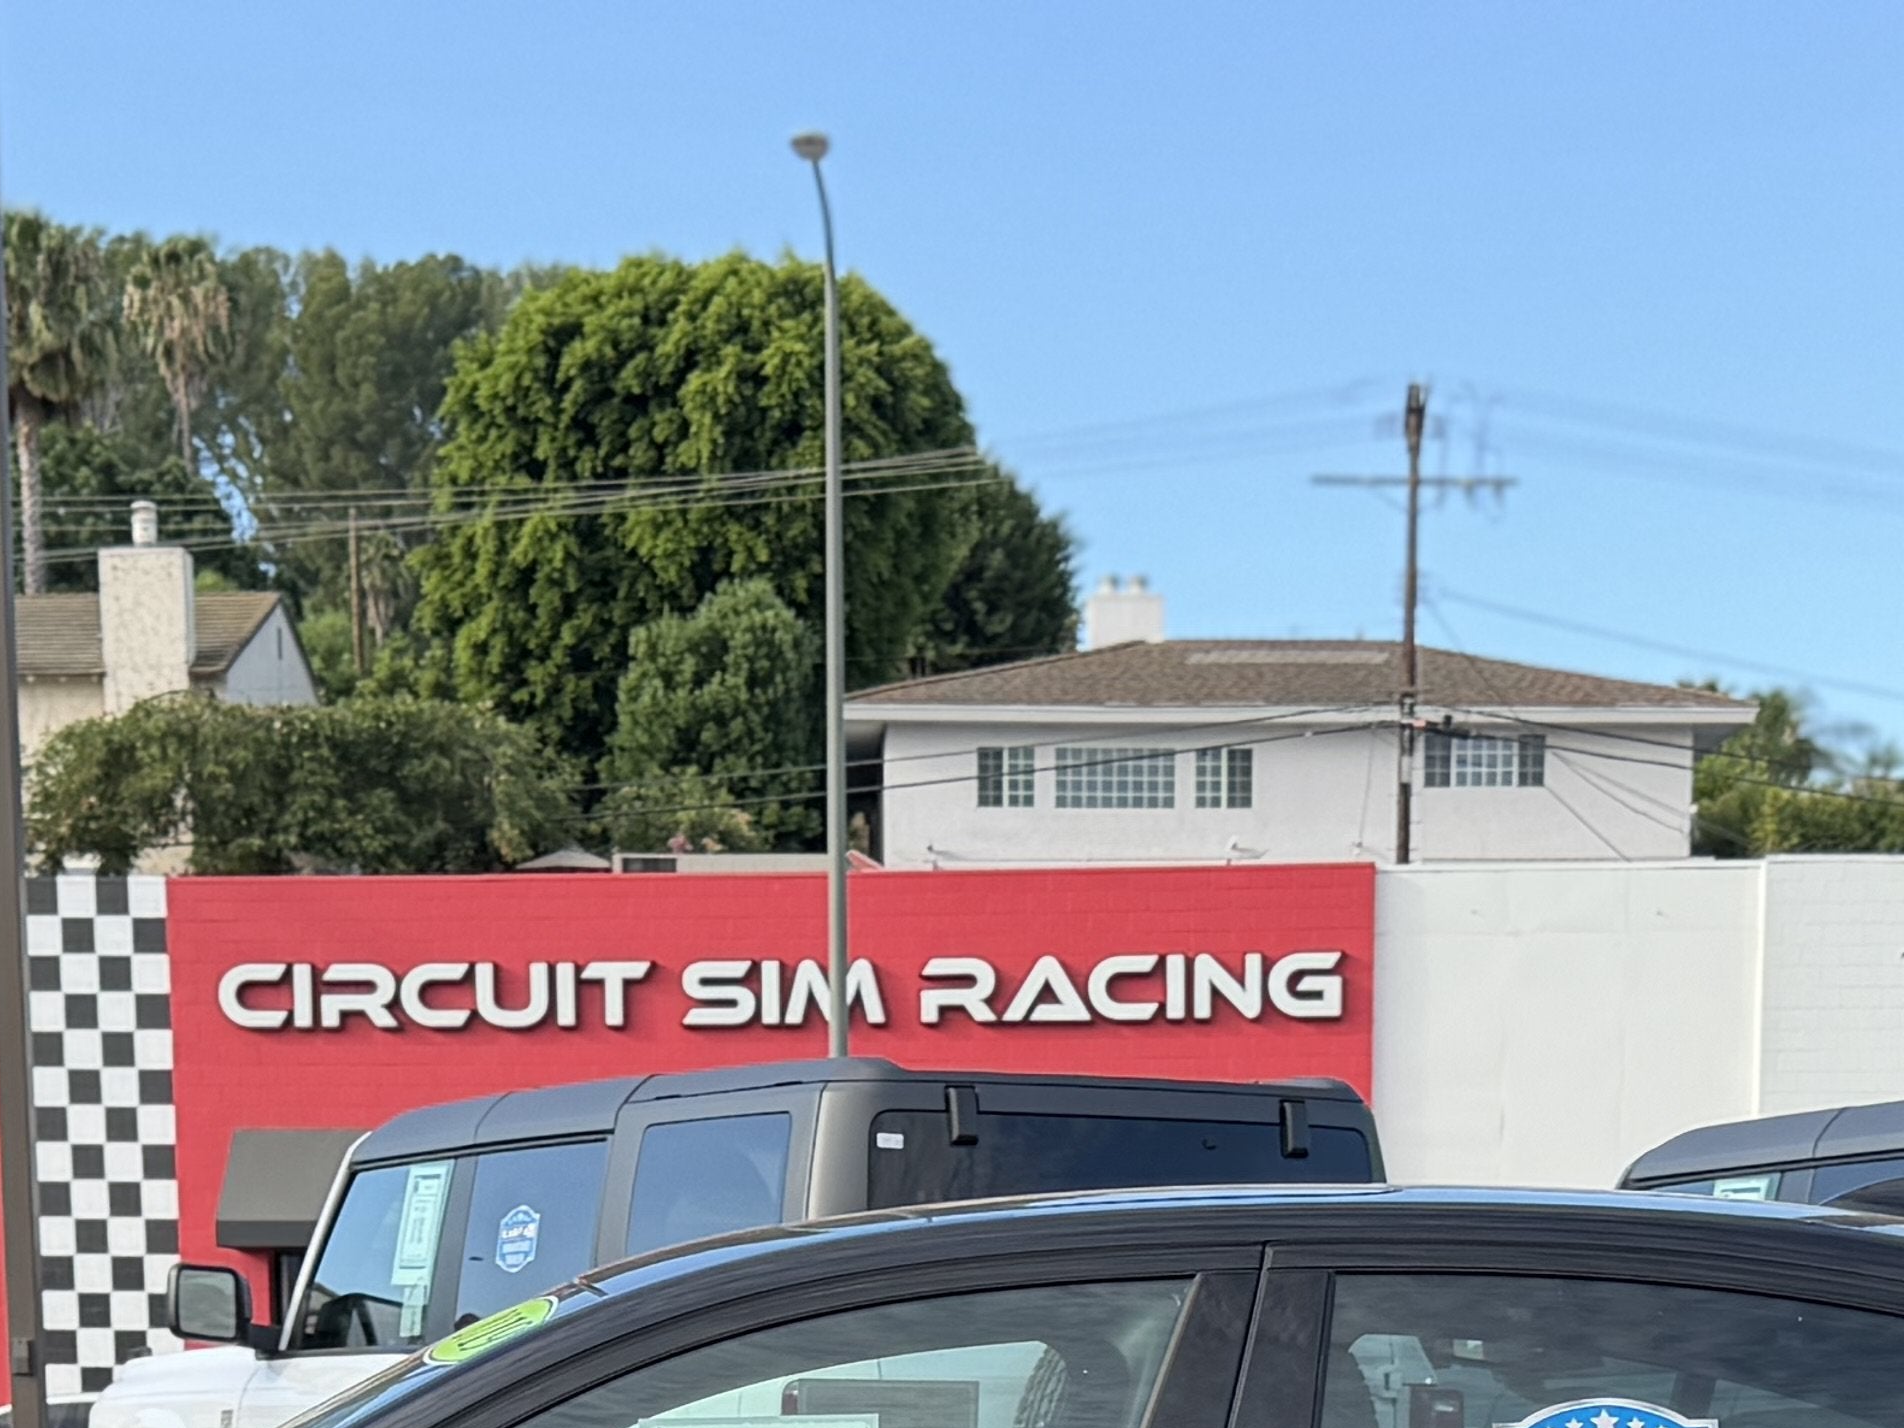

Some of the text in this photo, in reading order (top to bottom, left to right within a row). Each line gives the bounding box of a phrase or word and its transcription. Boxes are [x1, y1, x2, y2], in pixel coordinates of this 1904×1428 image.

[217, 950, 1343, 1030] CIRCUIT SIM RACING
